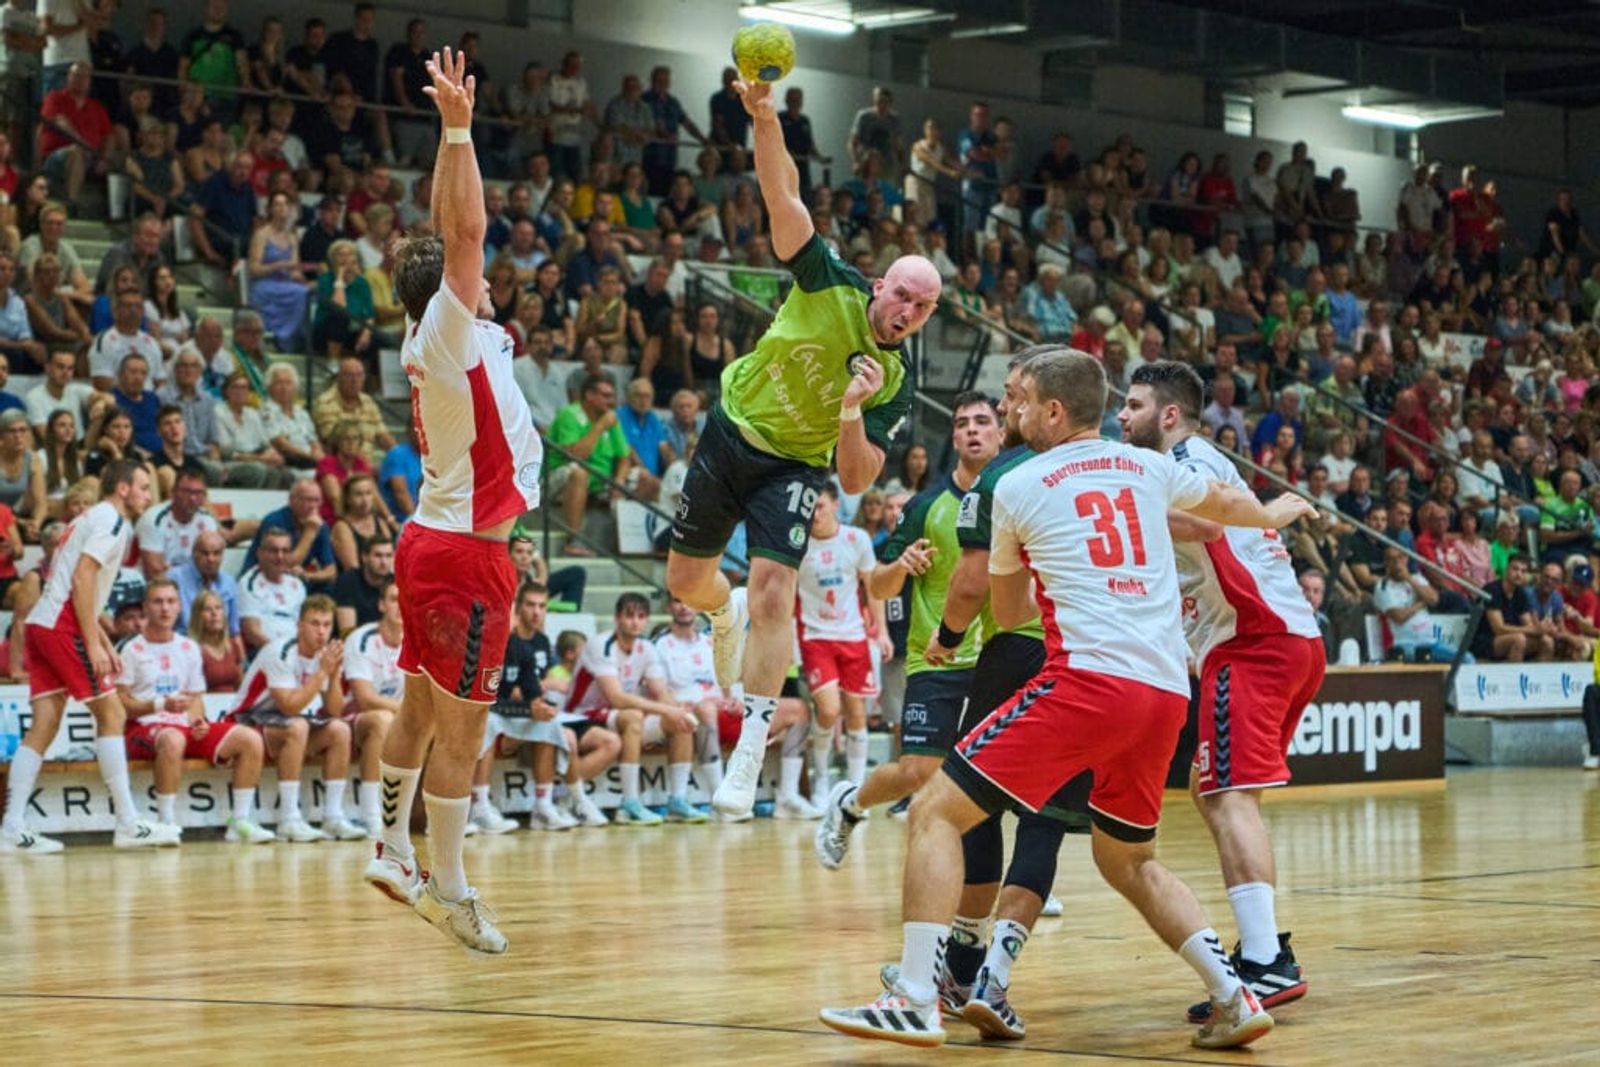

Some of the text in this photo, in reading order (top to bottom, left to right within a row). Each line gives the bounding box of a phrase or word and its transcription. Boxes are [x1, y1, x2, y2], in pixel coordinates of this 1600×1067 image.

[786, 480, 818, 519] 19
[1074, 487, 1147, 568] 31
[1287, 700, 1421, 772] empa
